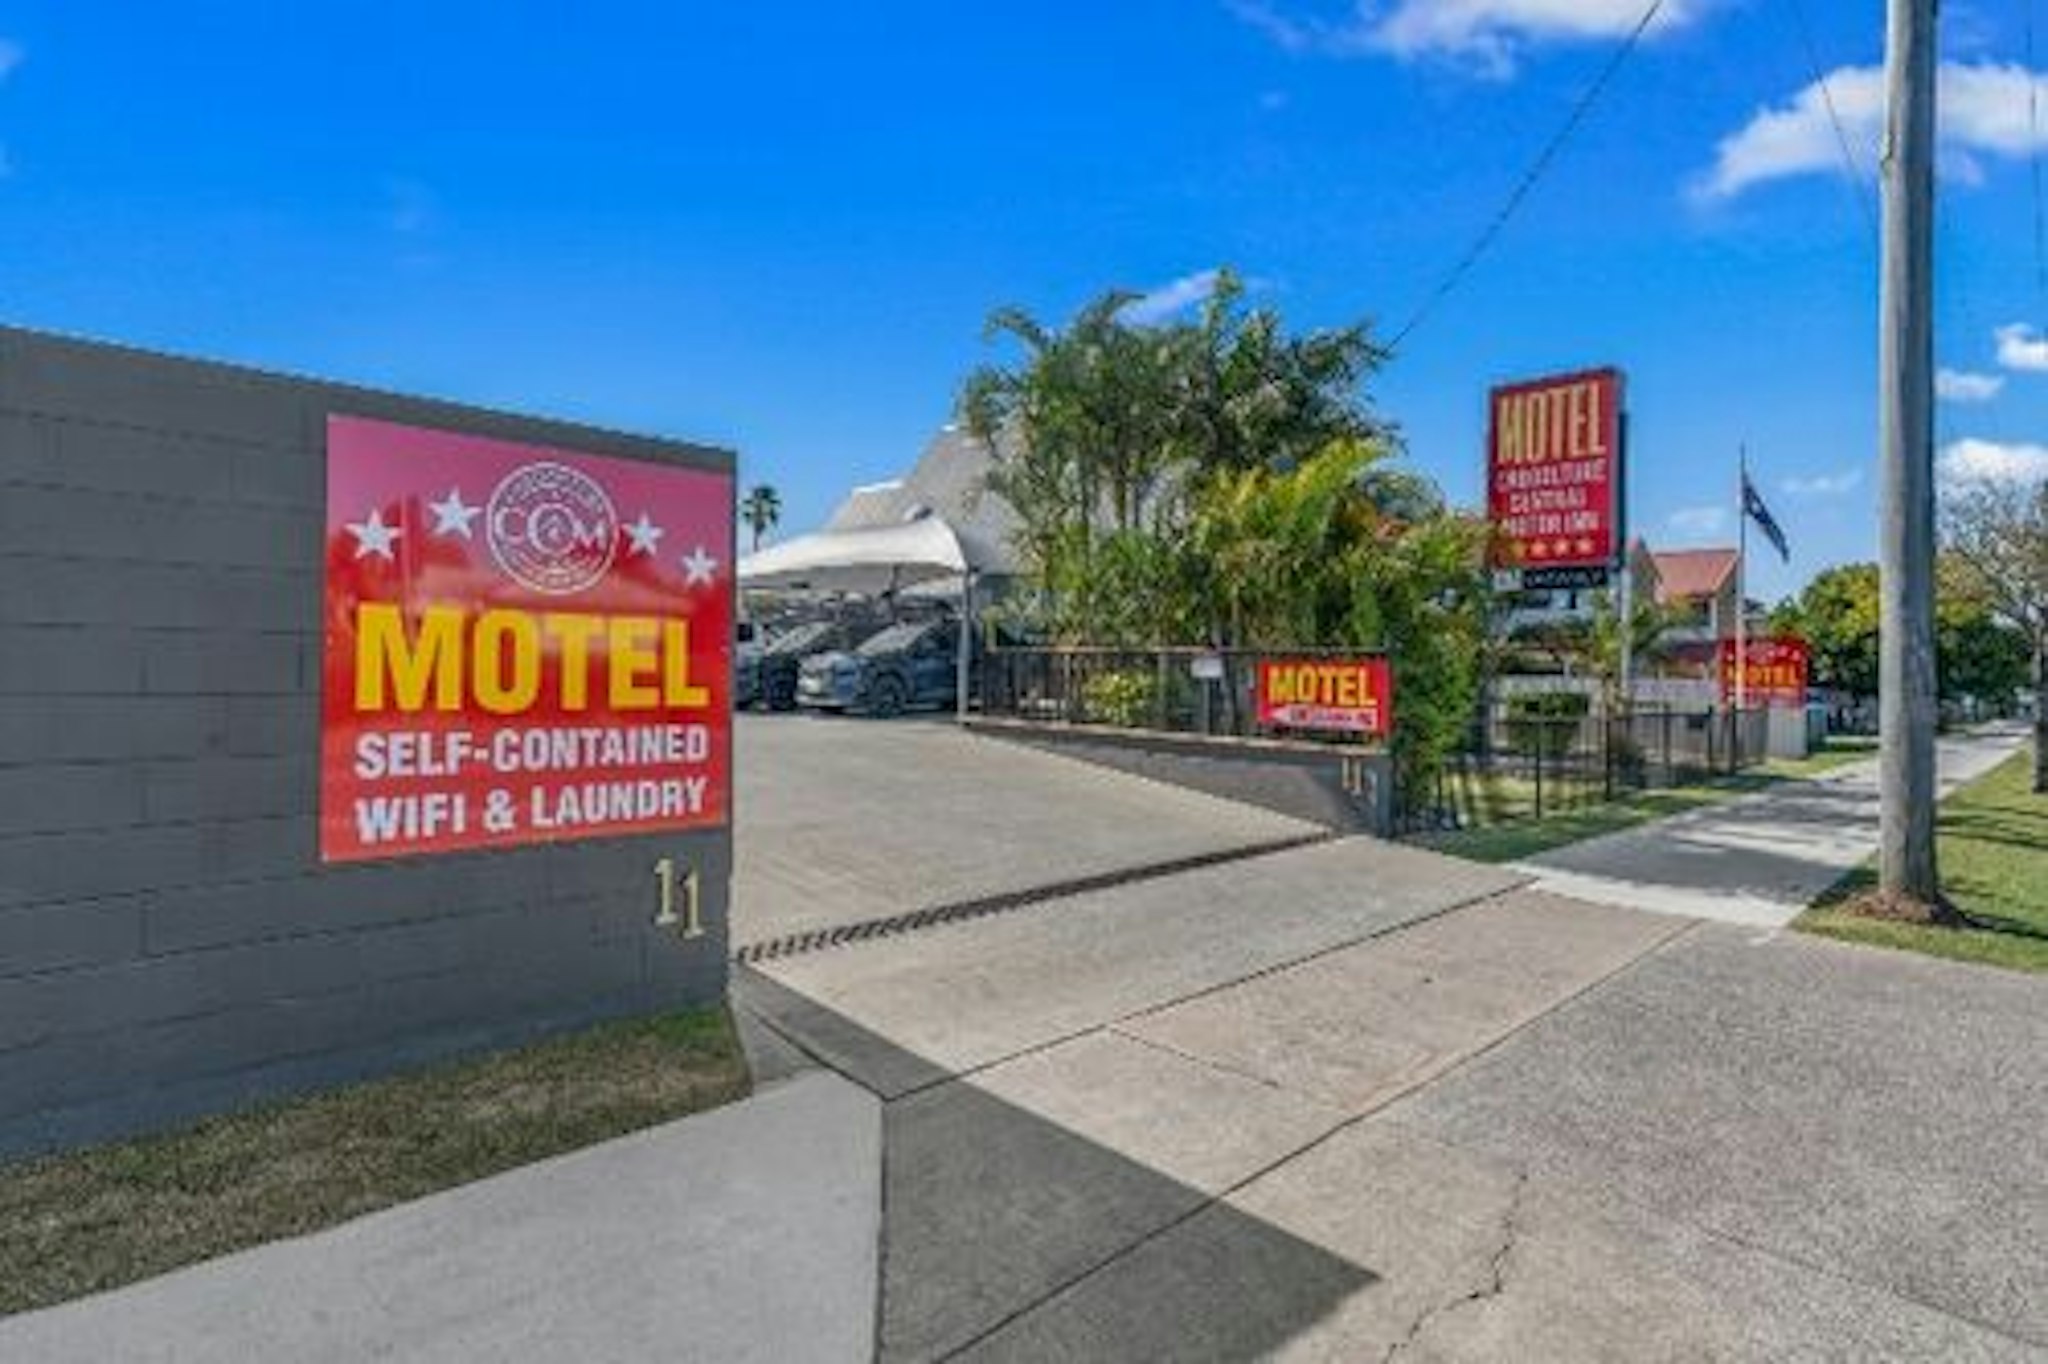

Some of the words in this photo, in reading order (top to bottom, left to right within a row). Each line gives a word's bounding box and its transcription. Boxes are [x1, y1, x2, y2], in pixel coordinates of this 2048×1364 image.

[1499, 380, 1606, 465] MOTEL
[355, 602, 710, 714] MOTEL
[1268, 664, 1378, 706] MOTEL
[354, 723, 708, 779] SELF-CONTAINED
[354, 793, 466, 844] WIFI
[483, 788, 516, 834] &
[531, 775, 707, 828] LAUNDRY
[653, 858, 706, 940] 11
